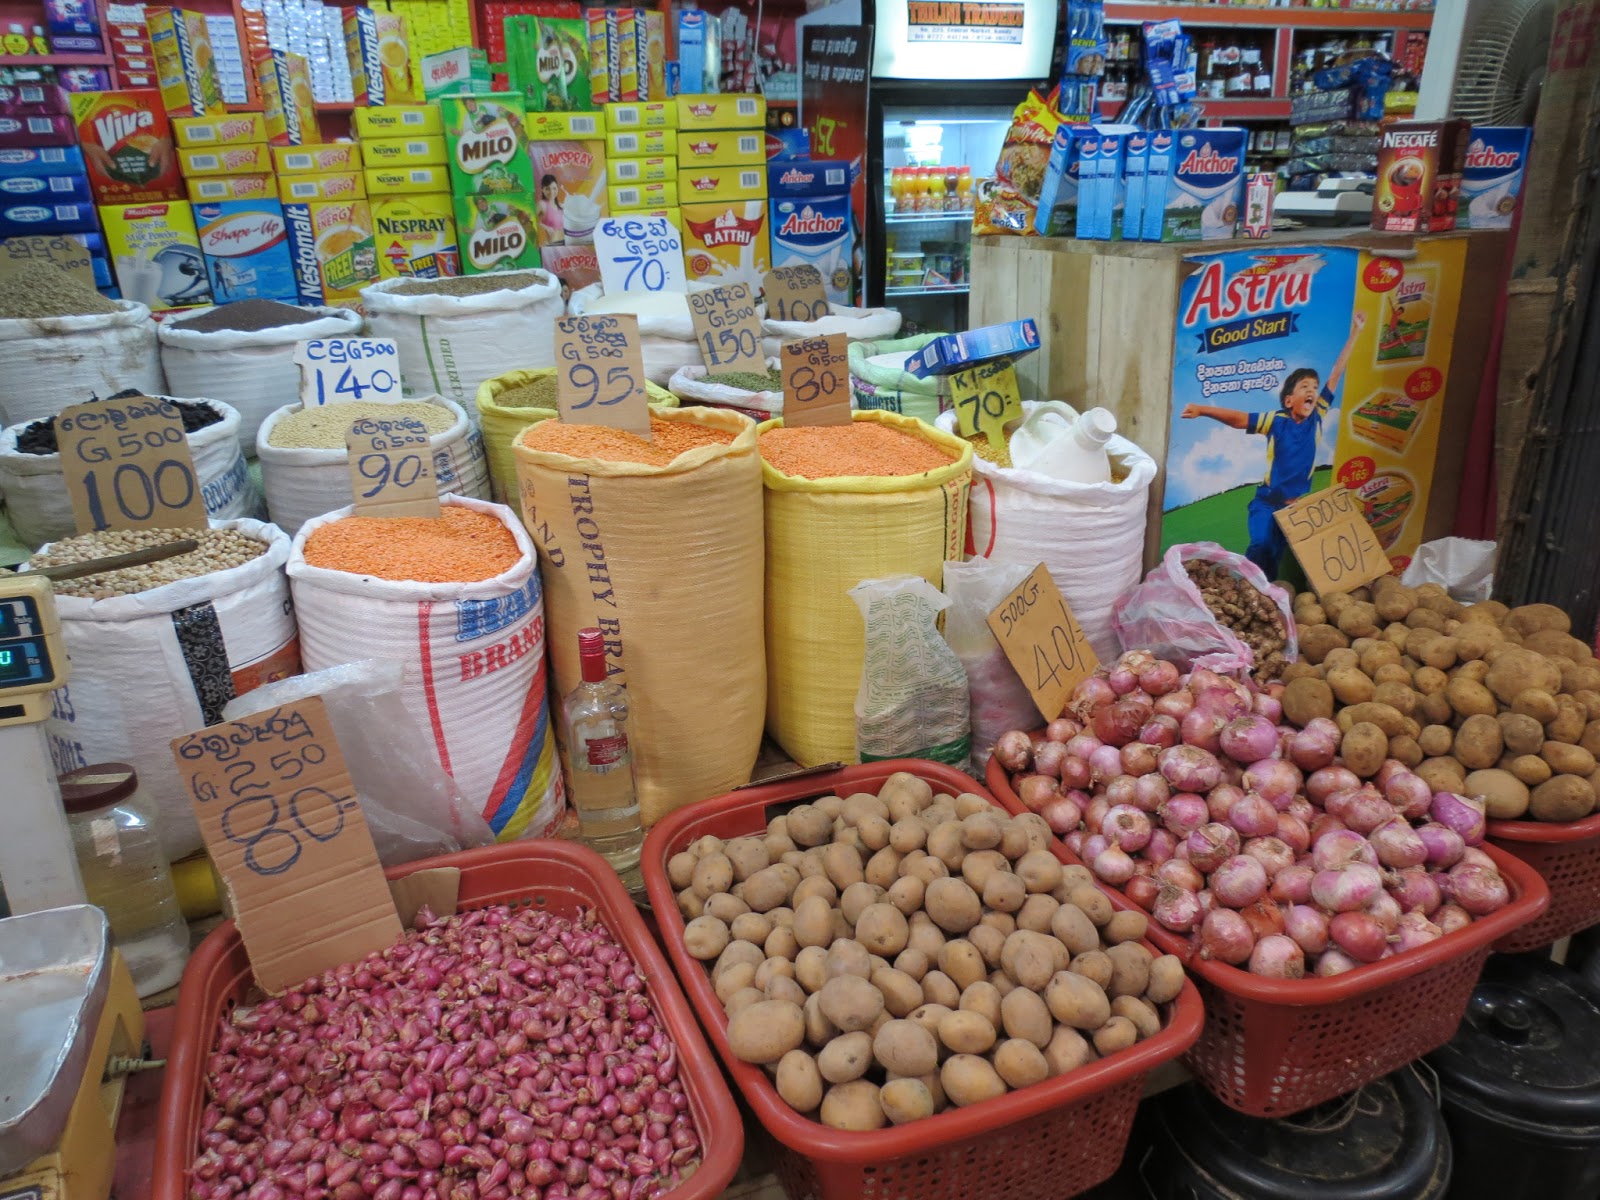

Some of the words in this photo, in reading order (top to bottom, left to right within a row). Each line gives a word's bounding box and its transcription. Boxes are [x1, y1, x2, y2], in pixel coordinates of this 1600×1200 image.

[173, 12, 206, 116] Nestomalt
[357, 8, 384, 105] Nestomalt
[608, 12, 620, 101] Nestomalt
[636, 12, 648, 101] Nestomalt
[274, 51, 303, 145] Nestomalt
[95, 110, 155, 151] Viva
[1383, 129, 1438, 148] NESCAFÉ
[462, 137, 513, 162] MILO
[541, 151, 594, 169] LAKSPRAY
[1178, 150, 1239, 175] Anchor
[1464, 146, 1519, 168] nchor
[780, 171, 815, 185] Anchor
[317, 203, 356, 231] ENERGY
[376, 217, 446, 235] NESPRAY
[780, 212, 844, 235] Anchor
[209, 218, 280, 247] Shape-Up
[704, 229, 750, 247] RATTHI
[287, 206, 323, 299] Nestomalt
[474, 233, 523, 259] MILO
[553, 255, 598, 273] LAKSPRA
[1395, 281, 1426, 296] Astra
[1210, 324, 1250, 347] Good
[1252, 316, 1287, 339] Start
[567, 472, 618, 608] TROPHY
